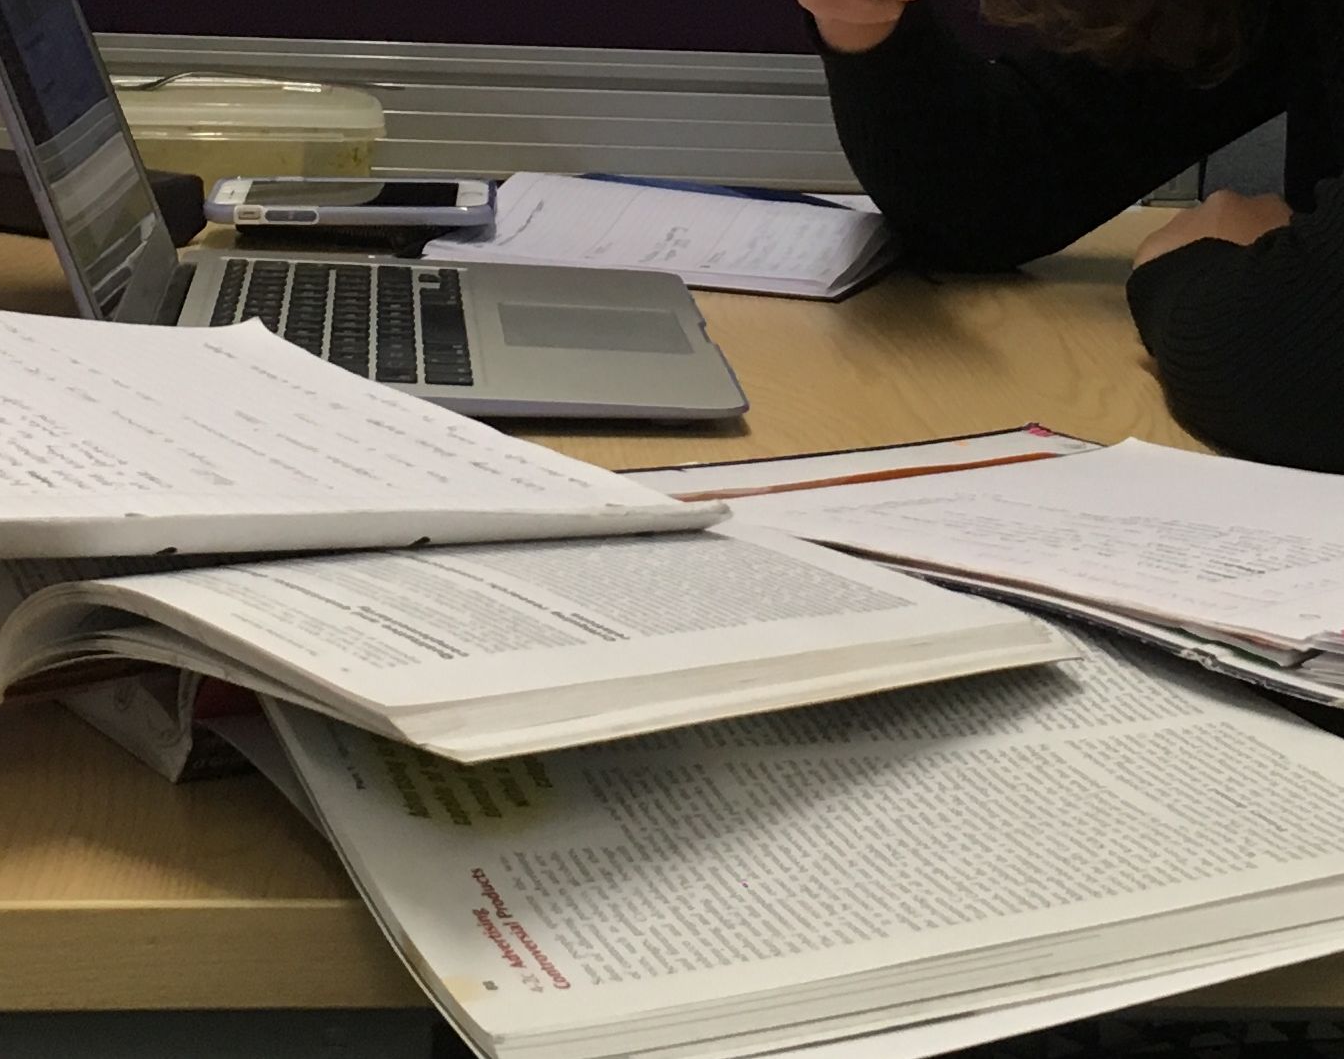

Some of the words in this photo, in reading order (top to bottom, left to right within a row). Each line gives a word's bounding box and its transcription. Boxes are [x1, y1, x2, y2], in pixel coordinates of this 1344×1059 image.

[471, 867, 513, 919] Products
[471, 908, 527, 968] Advertising
[502, 921, 571, 990] Controversial
